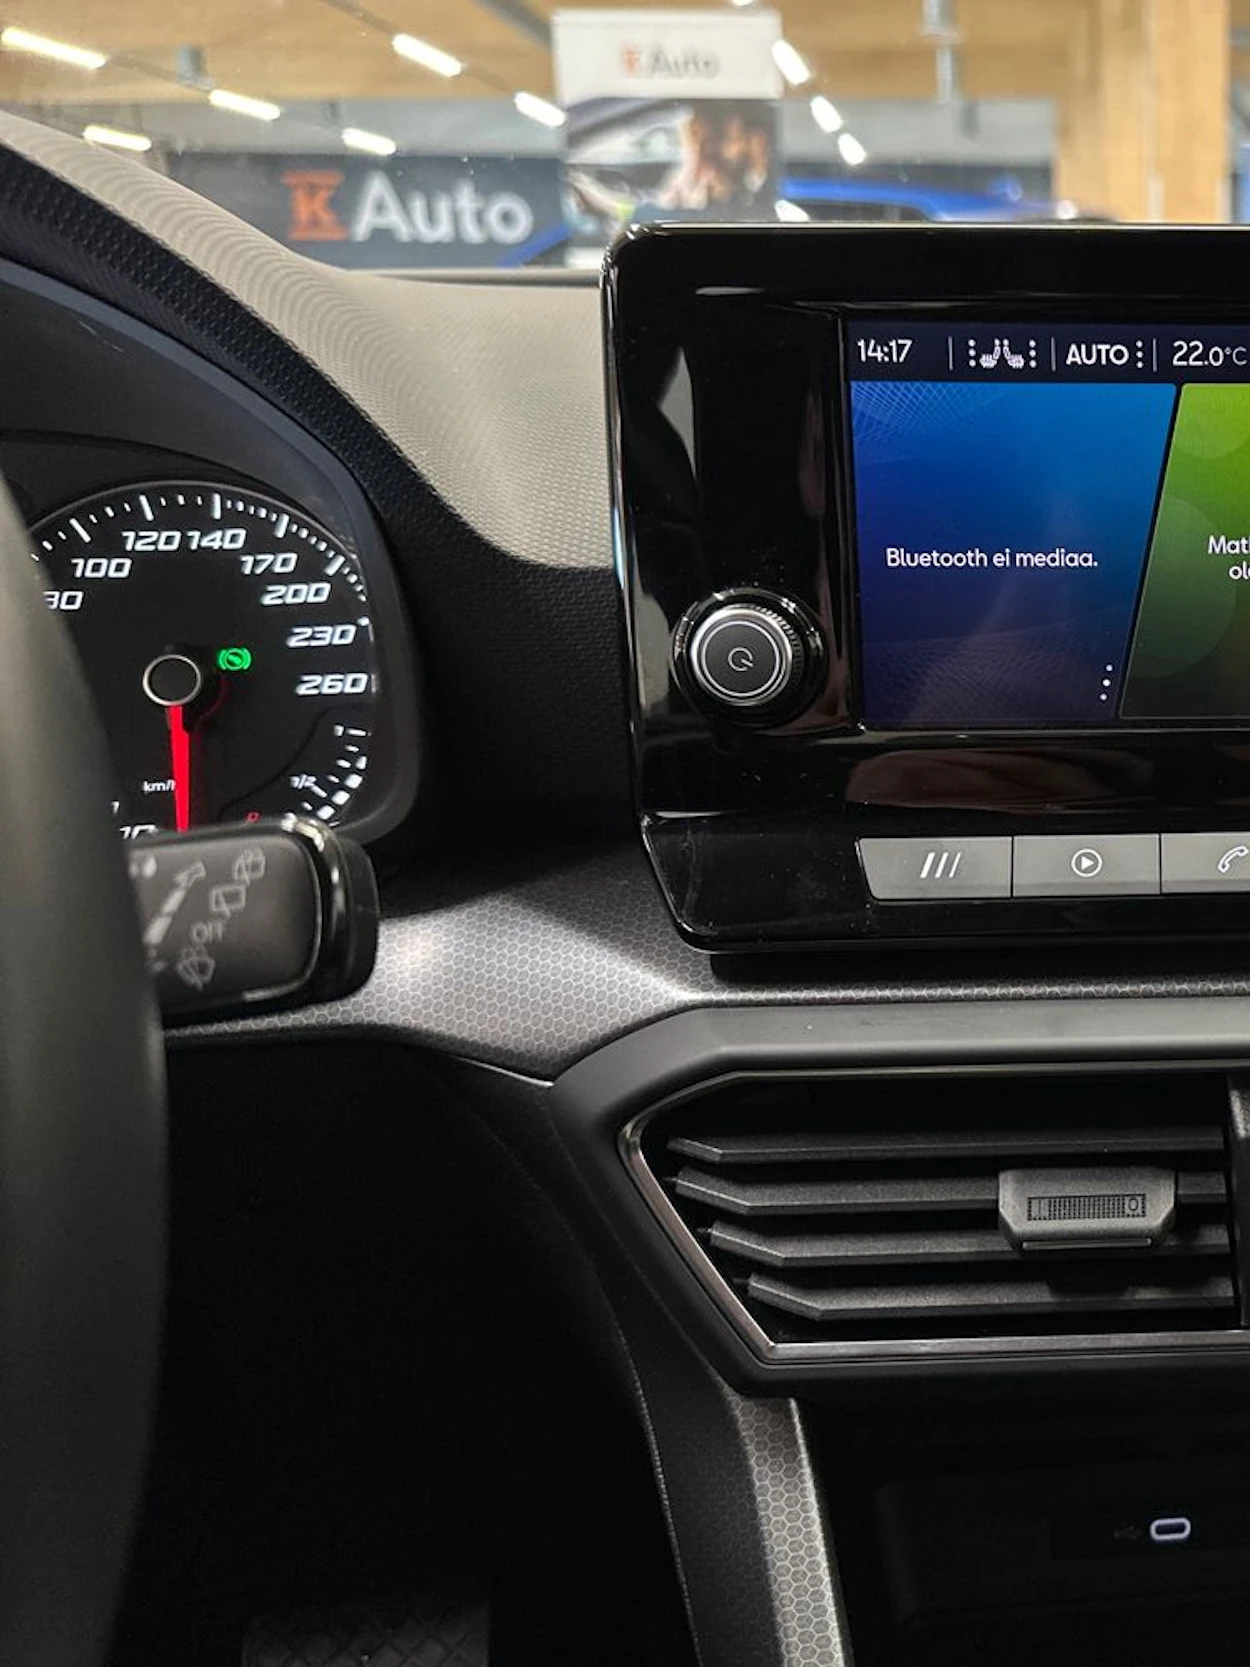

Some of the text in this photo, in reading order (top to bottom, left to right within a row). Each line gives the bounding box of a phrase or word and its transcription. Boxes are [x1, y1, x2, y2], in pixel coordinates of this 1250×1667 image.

[353, 170, 534, 244] Auto
[857, 339, 912, 363] 14:17
[1066, 343, 1129, 365] AUTO
[122, 531, 182, 552] 120
[187, 528, 247, 550] 140
[71, 557, 133, 579] 100
[239, 552, 298, 575] 170
[886, 547, 1099, 568] Bluetooth ei mediaa.
[262, 582, 331, 605] 200
[287, 624, 357, 648] 230
[296, 673, 368, 695] 260
